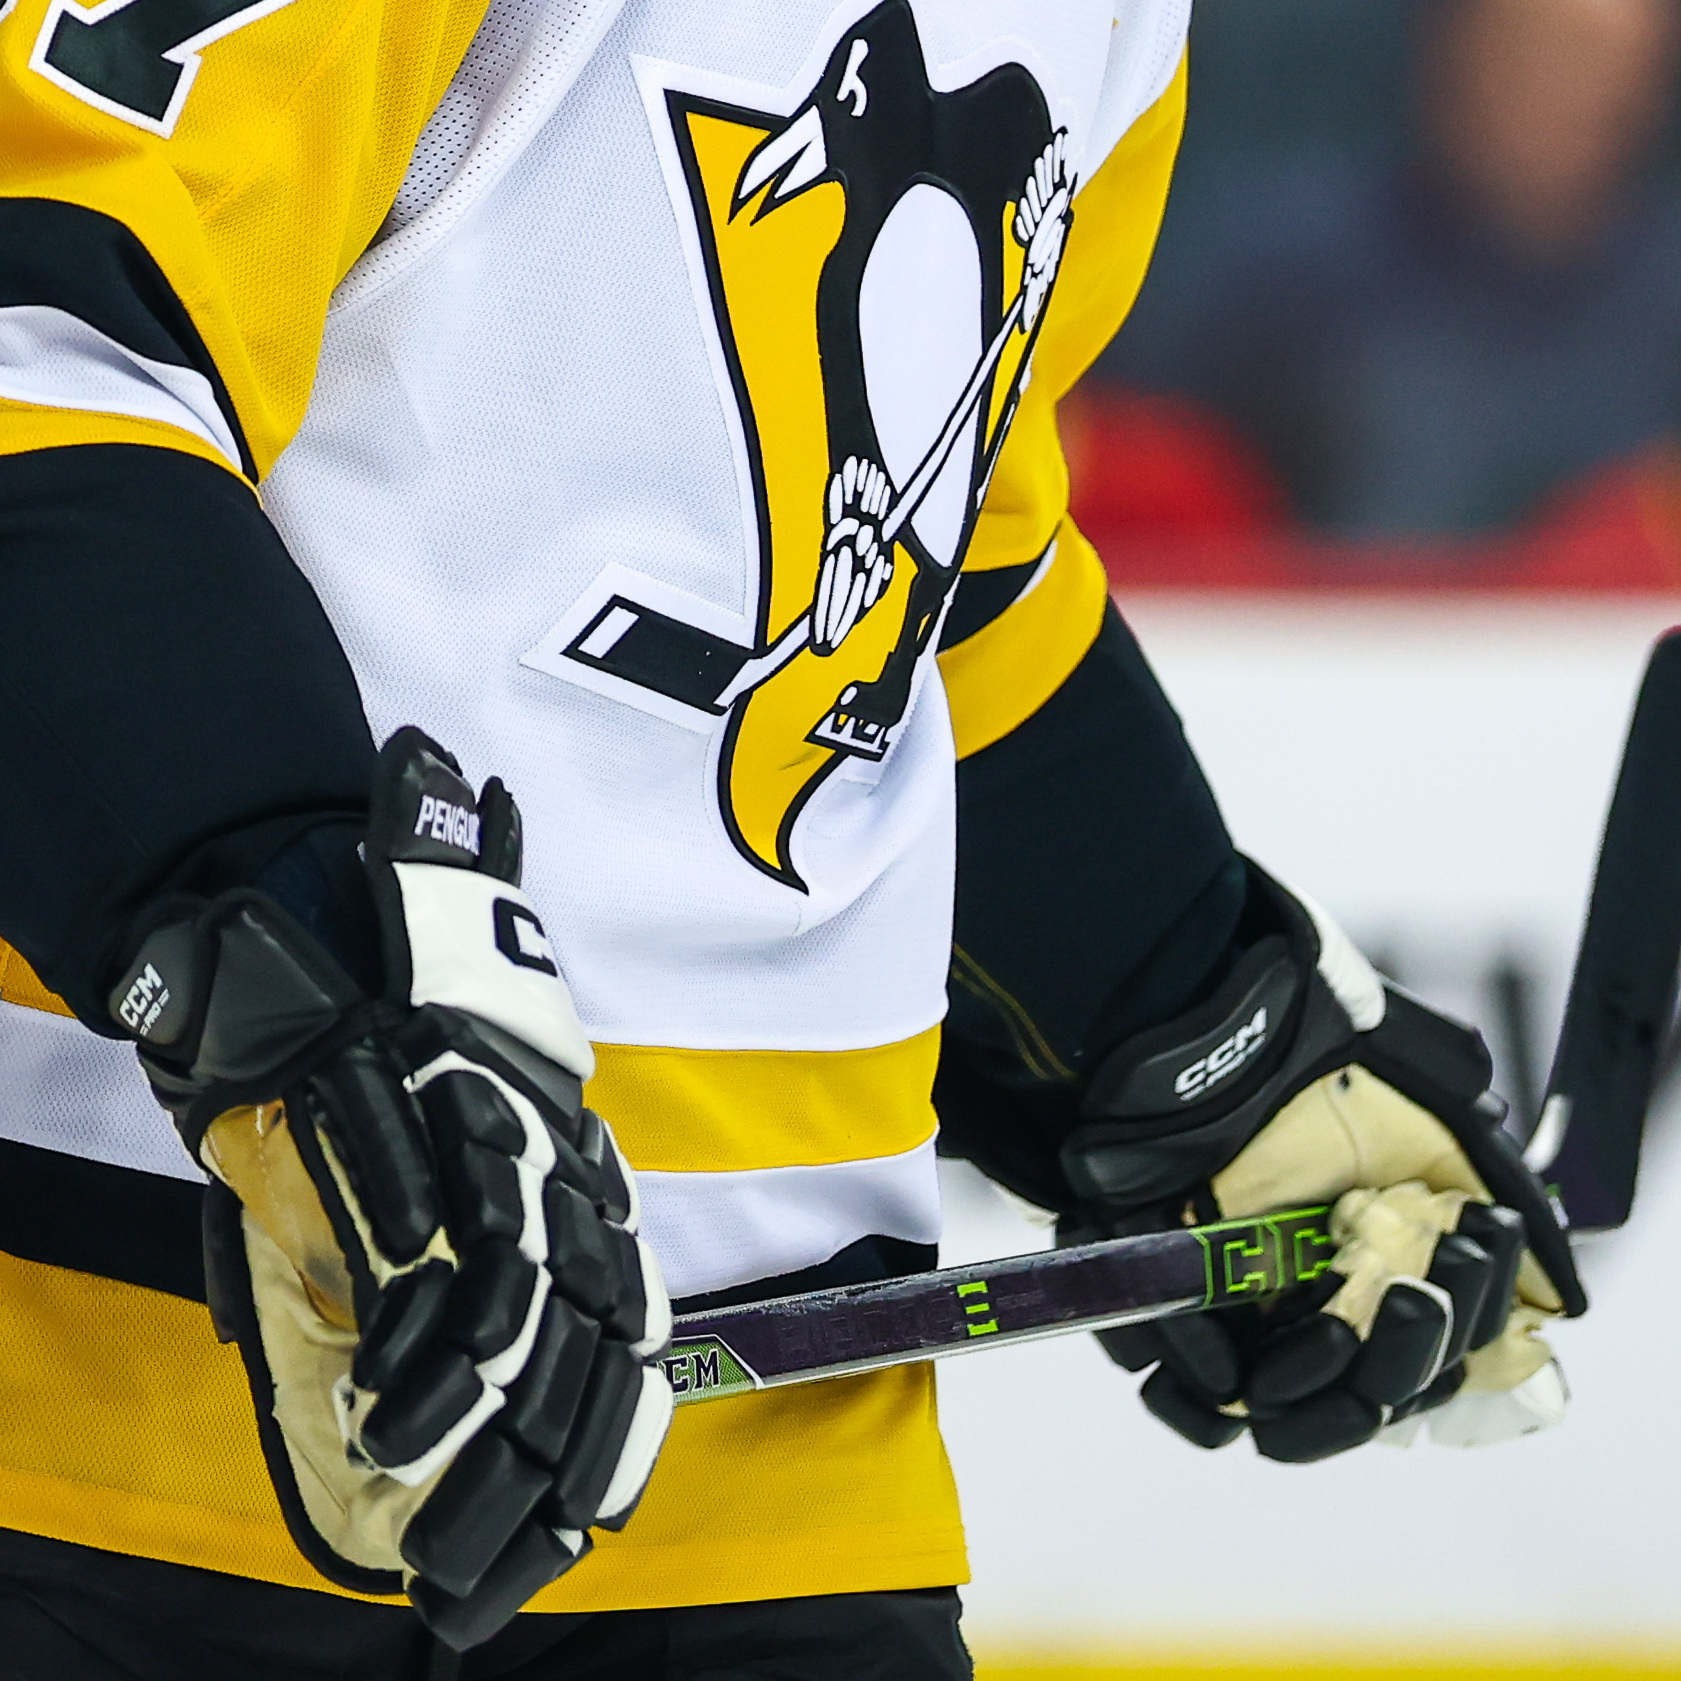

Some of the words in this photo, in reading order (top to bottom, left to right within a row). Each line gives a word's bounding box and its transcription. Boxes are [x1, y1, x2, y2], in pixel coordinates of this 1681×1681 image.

[492, 896, 558, 978] C
[119, 962, 164, 1028] CCM
[1174, 1006, 1267, 1093] CCM
[656, 1348, 721, 1394] CM
